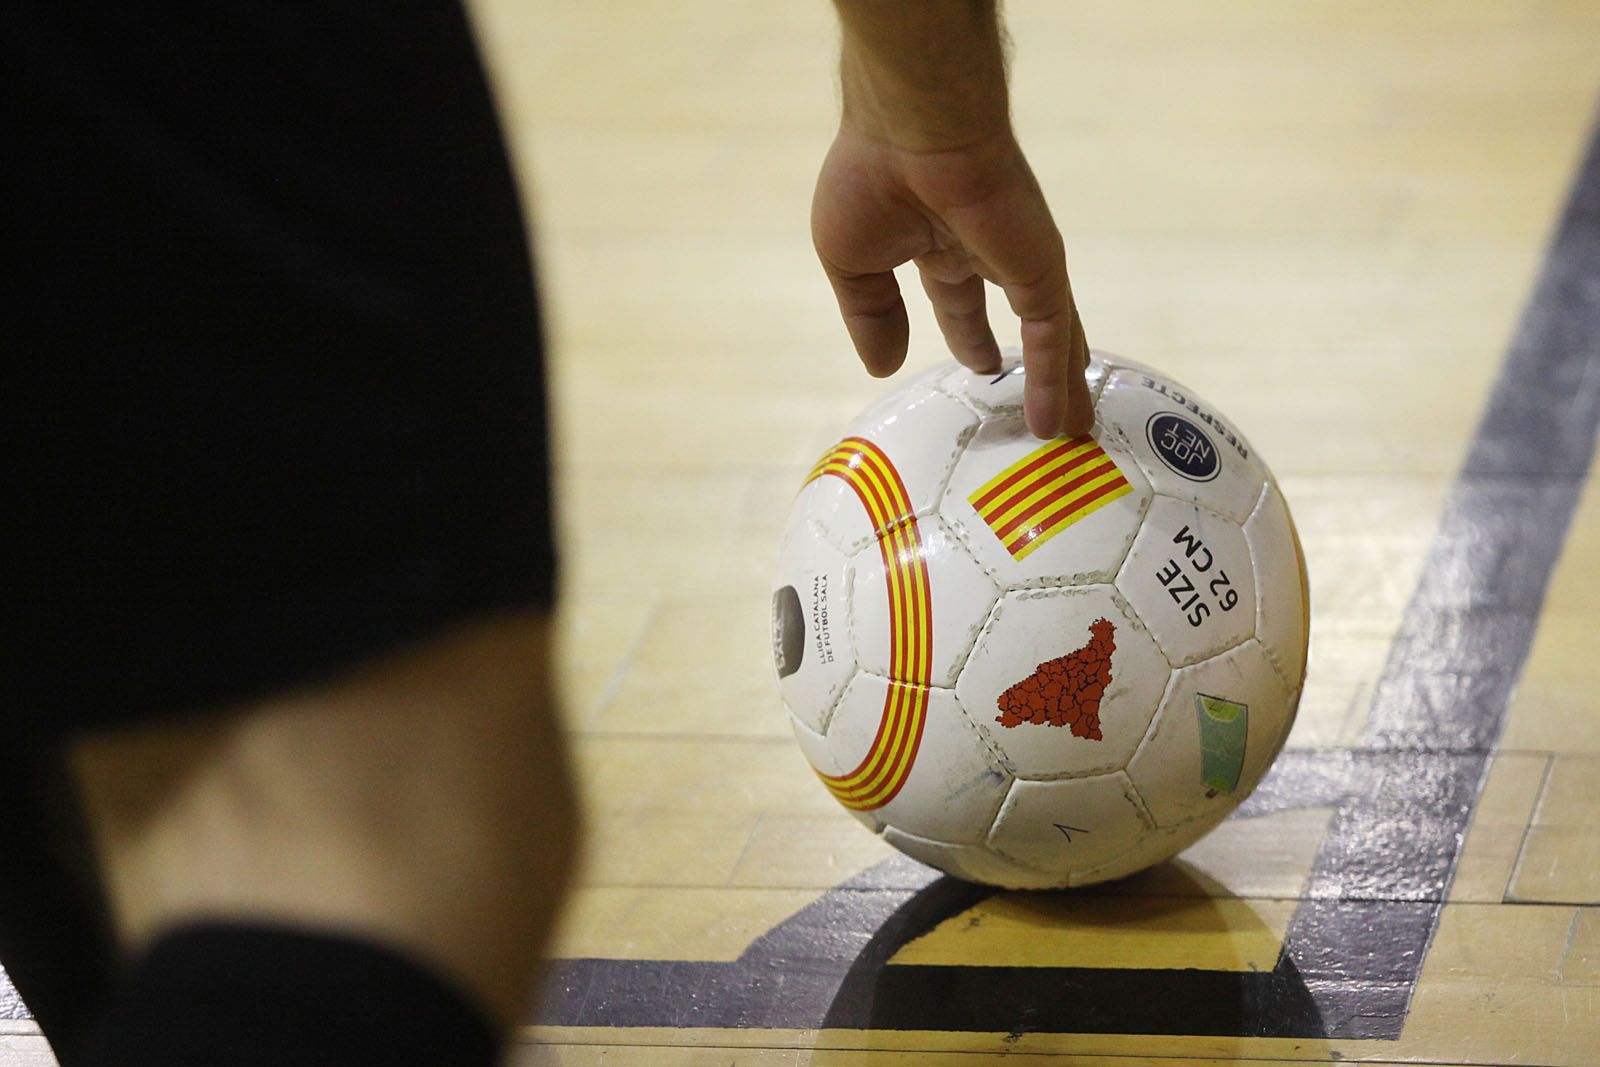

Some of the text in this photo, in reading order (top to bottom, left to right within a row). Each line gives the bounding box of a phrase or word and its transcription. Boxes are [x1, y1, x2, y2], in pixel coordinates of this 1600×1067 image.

[1141, 376, 1248, 460] RESPECTE
[1160, 433, 1204, 464] JOC
[1165, 422, 1210, 459] NET
[1172, 525, 1239, 612] 62 CM
[1155, 559, 1211, 627] SIZE
[821, 604, 830, 646] FUTBOL
[816, 633, 826, 664] LLIGA
[826, 650, 834, 662] DE
